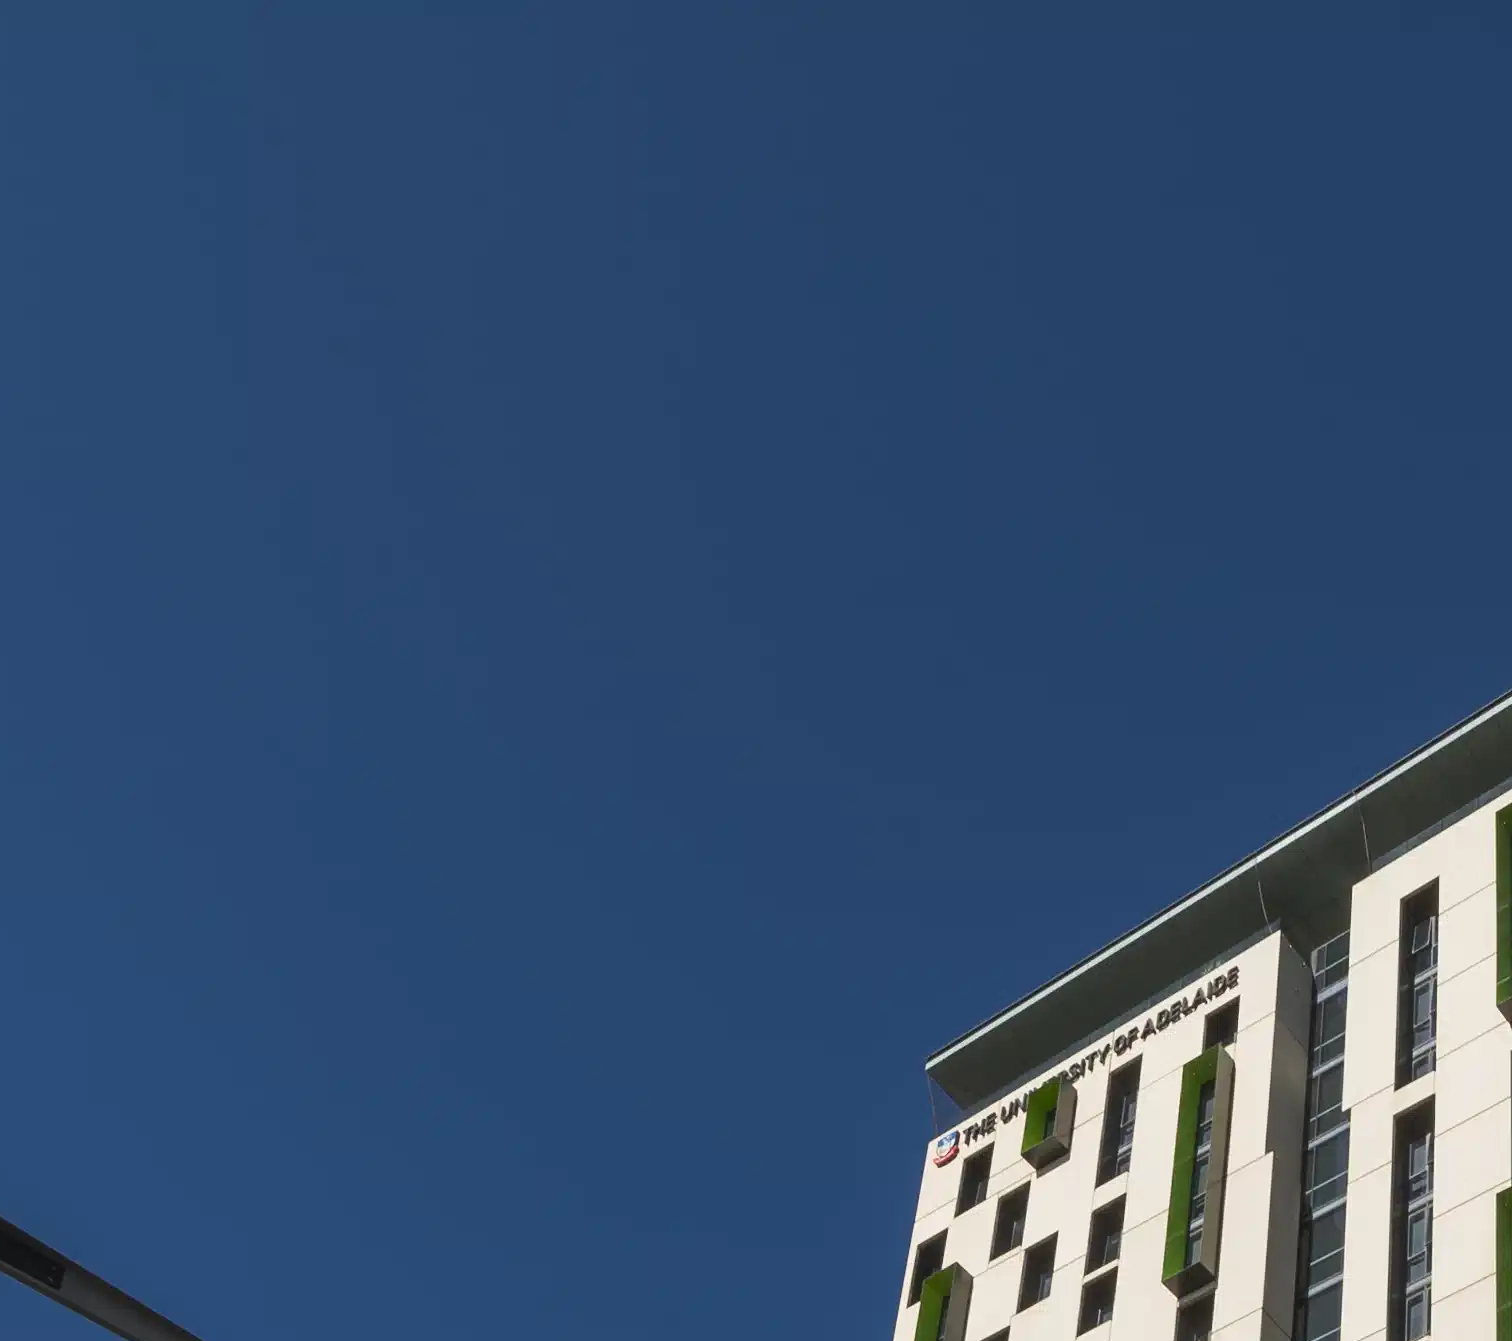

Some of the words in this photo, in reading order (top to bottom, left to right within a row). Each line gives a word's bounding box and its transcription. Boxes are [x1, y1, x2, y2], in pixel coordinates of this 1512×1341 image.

[963, 1110, 998, 1147] THE
[999, 1043, 1112, 1125] UNRSITY
[1113, 1026, 1140, 1057] OF
[1139, 966, 1240, 1042] ADELAIDE
